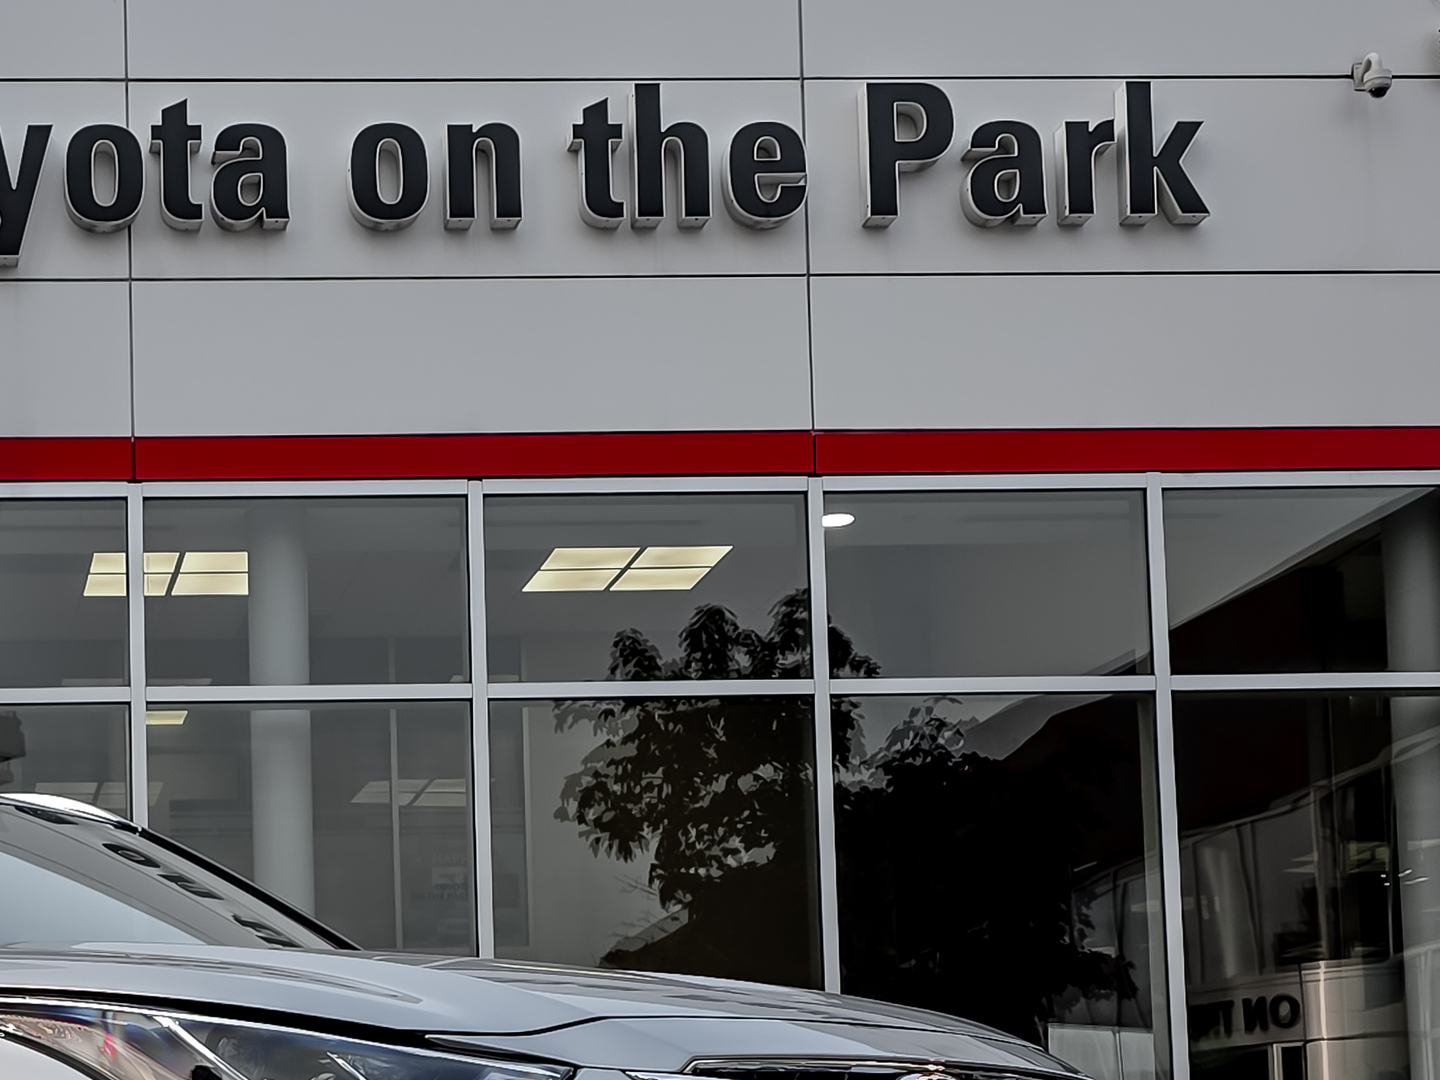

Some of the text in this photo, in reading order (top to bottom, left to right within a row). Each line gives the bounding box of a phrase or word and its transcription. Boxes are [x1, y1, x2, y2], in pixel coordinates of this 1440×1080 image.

[348, 121, 523, 231] on
[567, 82, 807, 228] the
[858, 81, 1210, 228] Park
